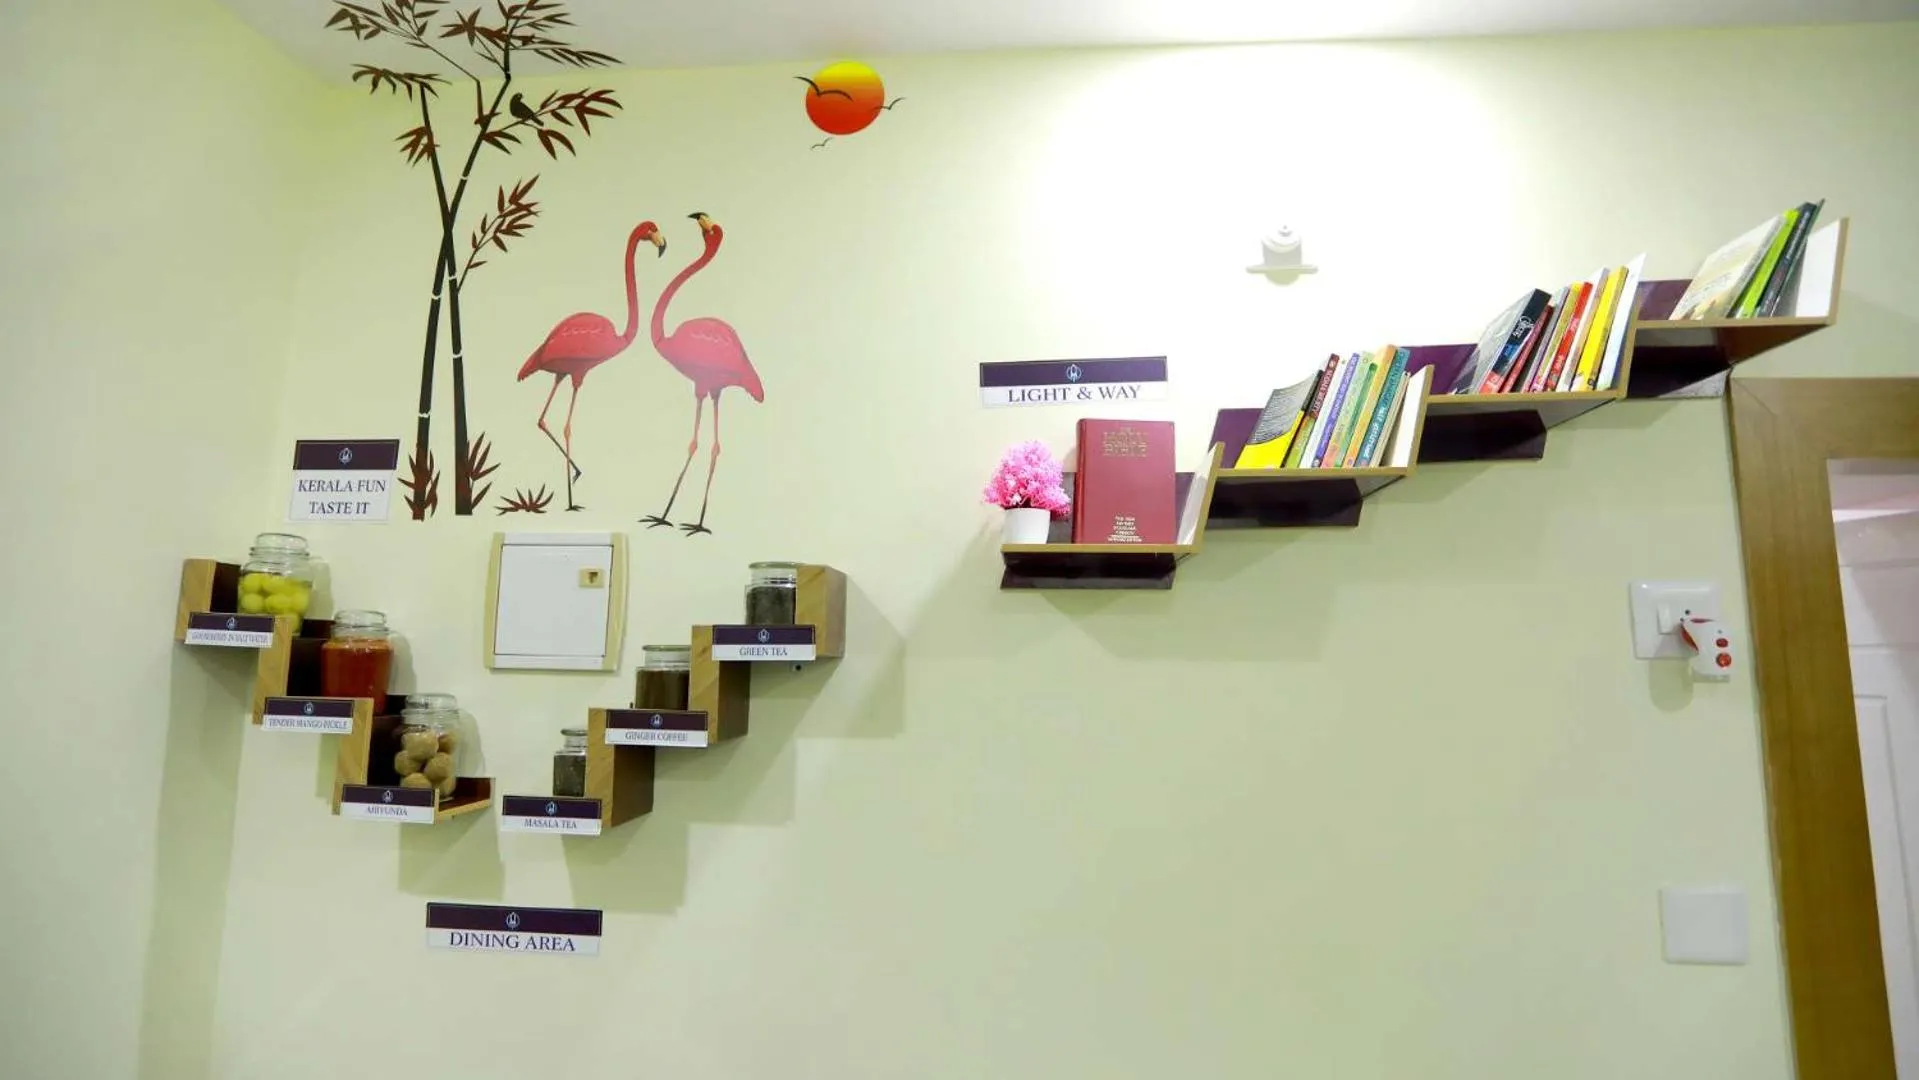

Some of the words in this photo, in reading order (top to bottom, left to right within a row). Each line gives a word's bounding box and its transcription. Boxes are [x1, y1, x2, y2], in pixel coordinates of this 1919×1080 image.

[1008, 387, 1071, 403] LIGHT
[1076, 386, 1092, 400] &
[1098, 384, 1142, 400] WAY
[298, 479, 353, 493] KERALA
[357, 479, 386, 493] FUN
[309, 501, 352, 514] TASTE
[355, 501, 371, 514] IT
[739, 646, 769, 656] GREEN
[771, 646, 788, 656] TEA
[625, 731, 657, 741] GINGER
[657, 732, 688, 742] COFFEE
[524, 818, 558, 829] MASALA
[561, 819, 577, 830] TEA
[450, 931, 519, 949] DINING
[525, 936, 575, 952] AREA
